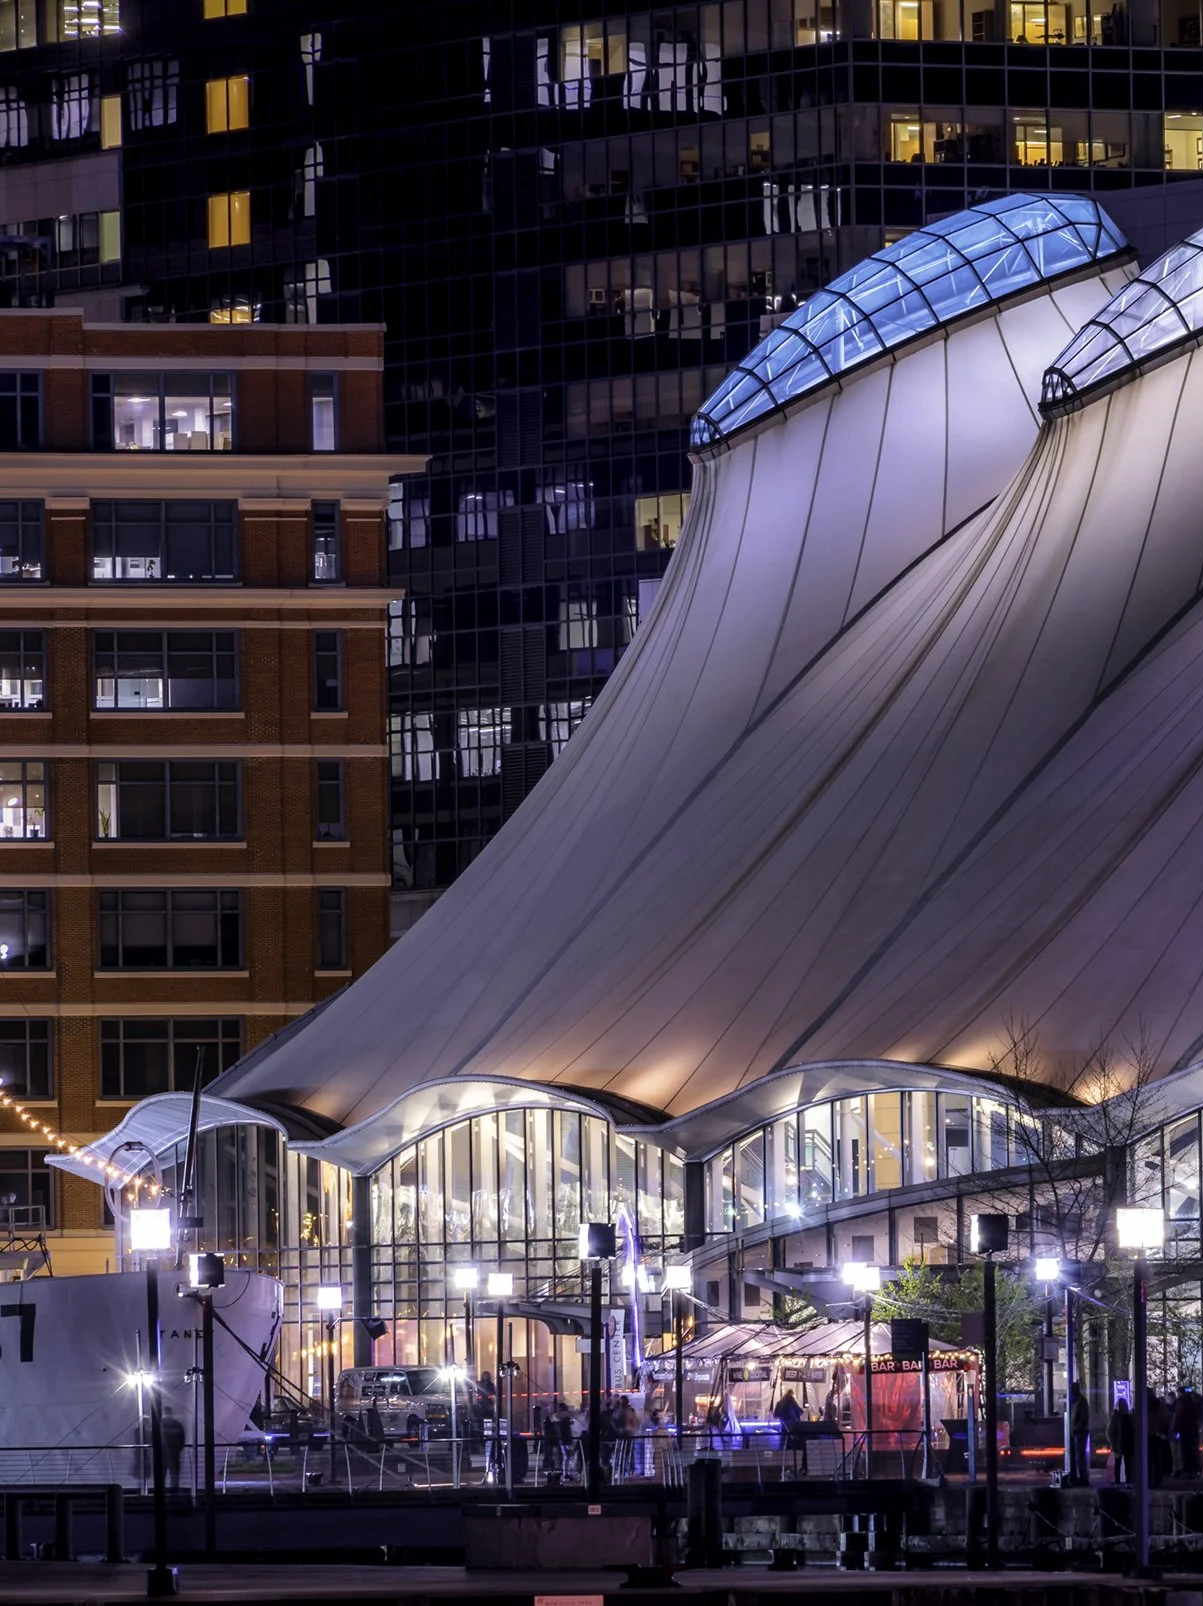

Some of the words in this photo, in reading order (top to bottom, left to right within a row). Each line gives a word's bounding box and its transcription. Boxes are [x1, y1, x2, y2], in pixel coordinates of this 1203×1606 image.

[0, 1303, 36, 1363] 7
[159, 1329, 214, 1340] TANE
[613, 1320, 622, 1362] CENTER
[871, 1361, 895, 1372] BAR
[934, 1359, 958, 1369] BAR
